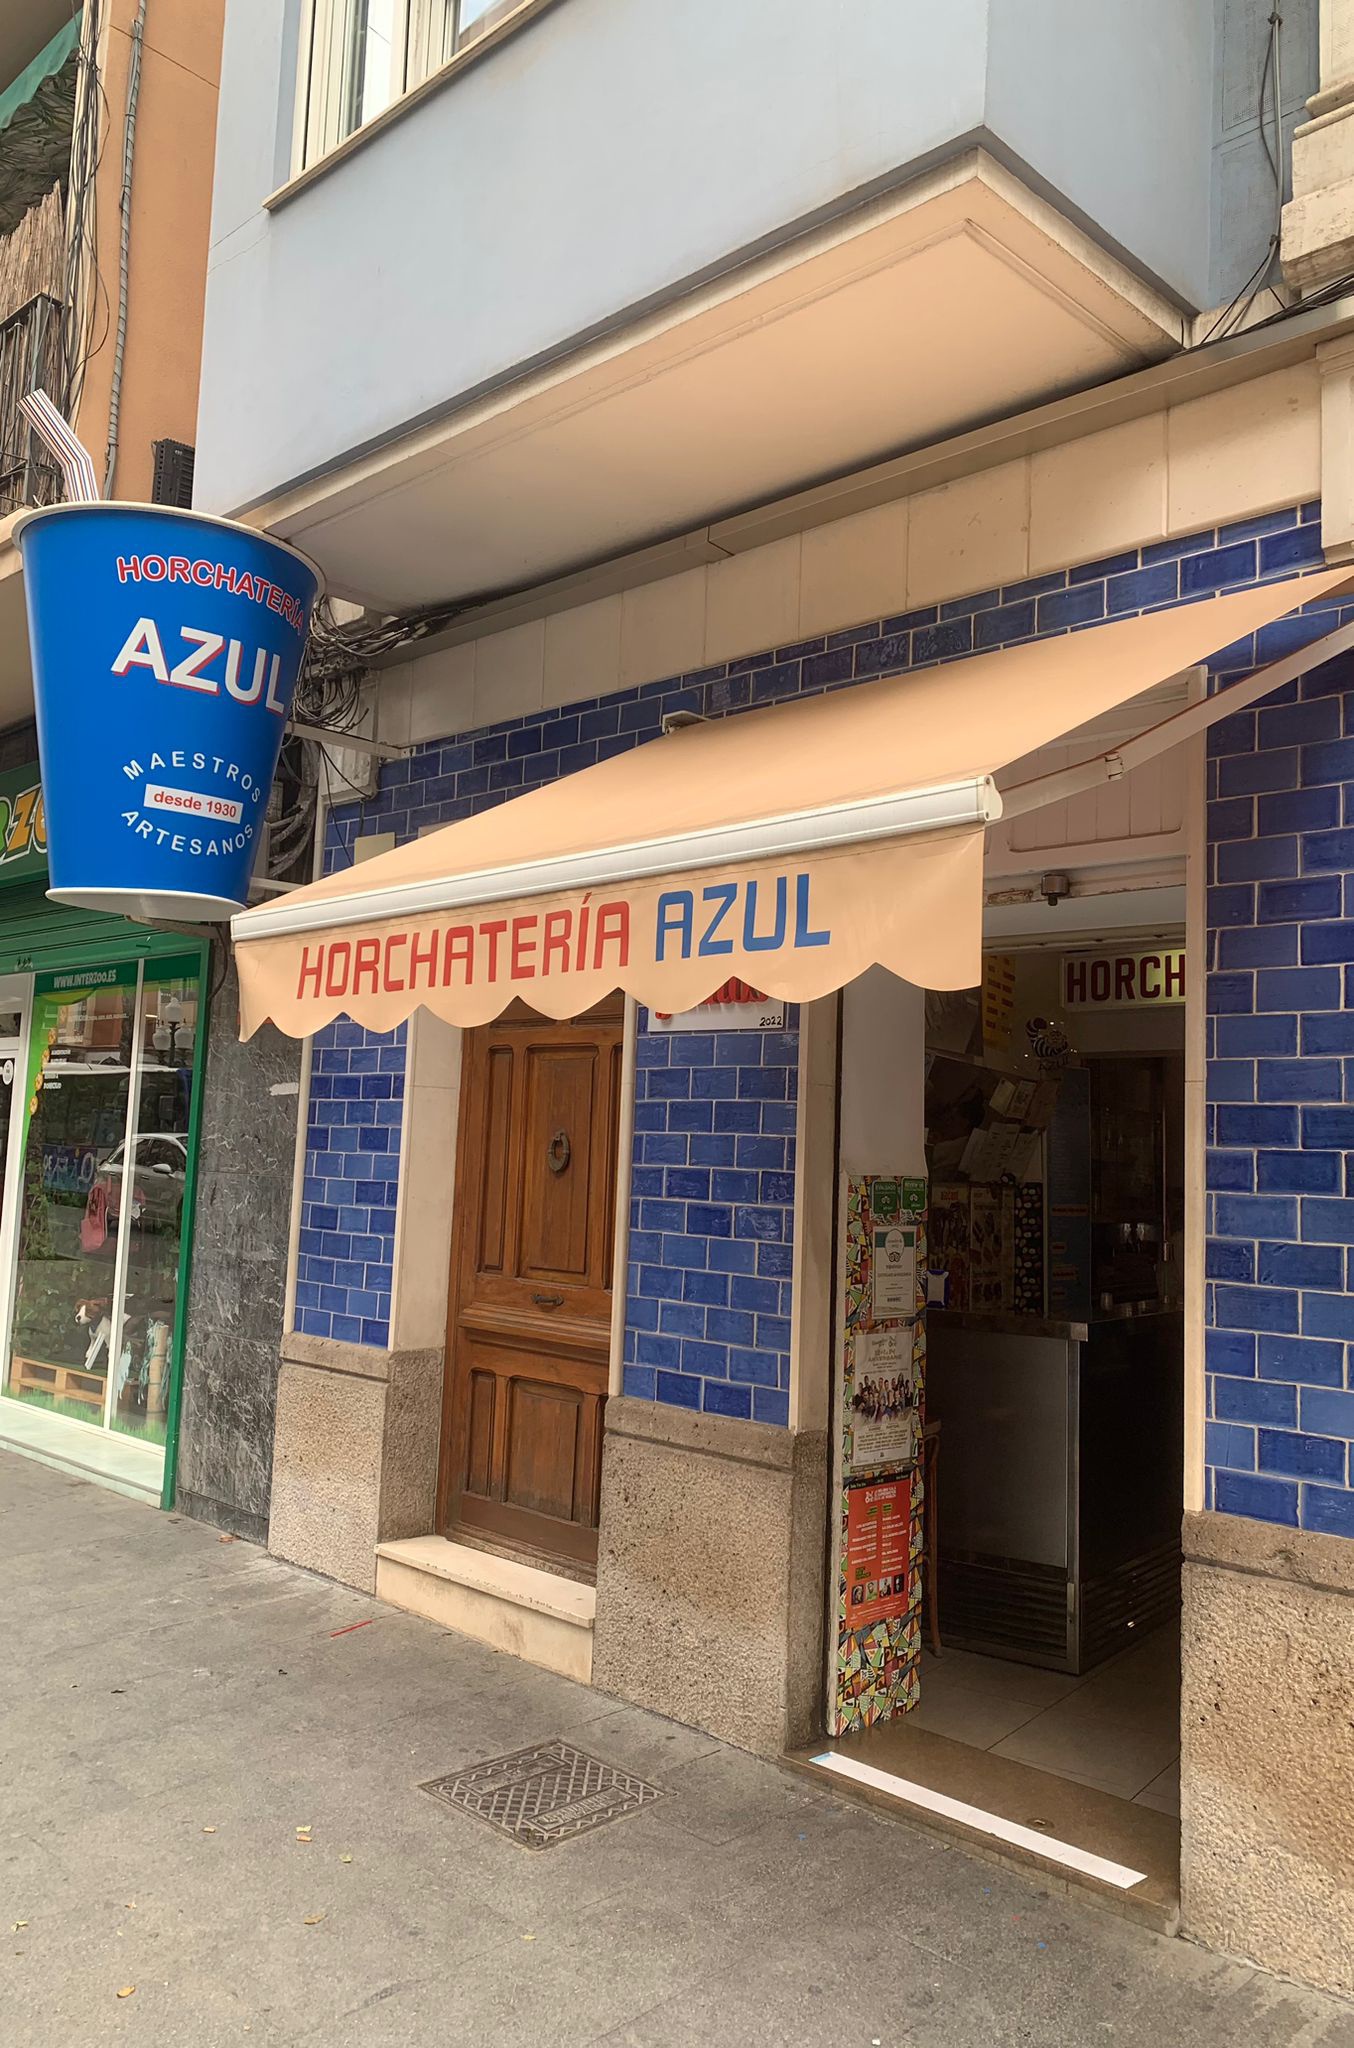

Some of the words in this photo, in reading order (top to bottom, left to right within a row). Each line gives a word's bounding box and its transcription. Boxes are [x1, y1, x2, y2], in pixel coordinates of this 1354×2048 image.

[116, 554, 303, 635] HORCHATERÍA
[110, 616, 285, 717] AZUL
[122, 750, 261, 803] MAESTROS
[153, 790, 201, 811] desde
[206, 799, 237, 819] 1930
[121, 809, 253, 856] ARTESANOS
[296, 892, 631, 1000] HORCHATERÍA
[655, 873, 831, 963] AZUL
[1067, 954, 1186, 1003] HORCH
[759, 1016, 782, 1027] 2022
